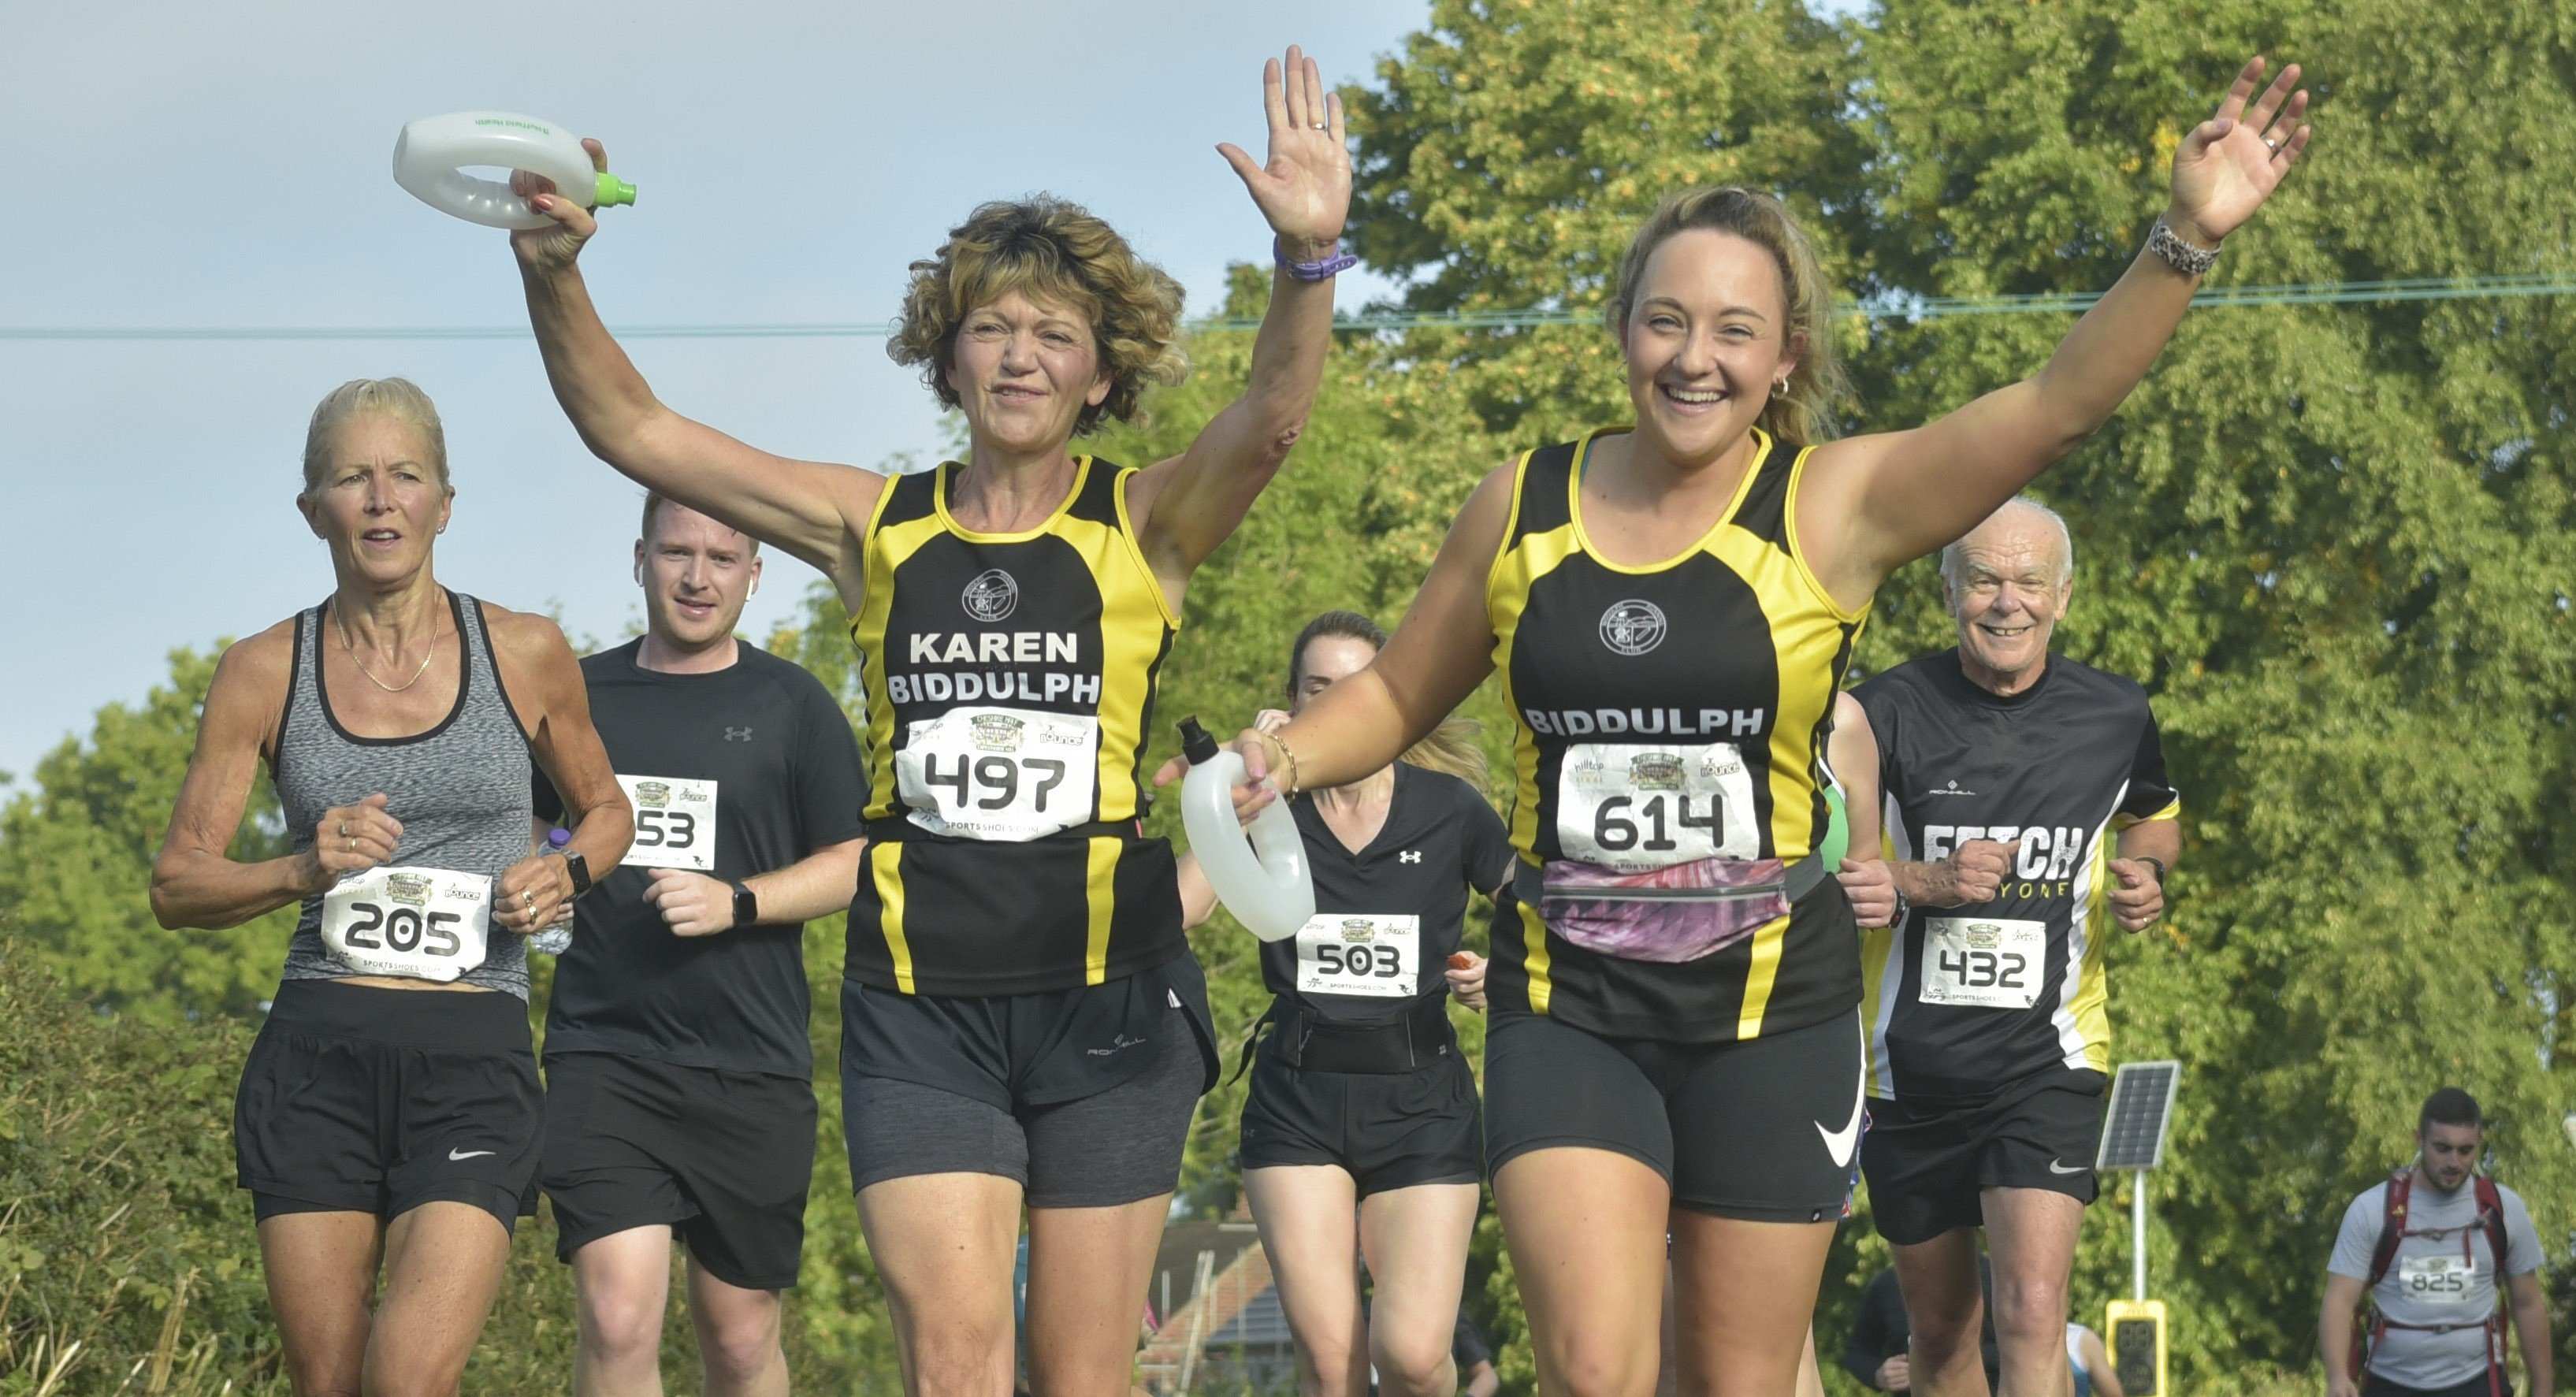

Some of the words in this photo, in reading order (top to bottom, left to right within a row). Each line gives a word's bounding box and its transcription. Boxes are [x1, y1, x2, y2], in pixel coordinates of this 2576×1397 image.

[909, 632, 1077, 663] KAREN
[887, 671, 1100, 704] BIDDULPH
[1525, 708, 1764, 737] BIDDULPH
[925, 752, 1066, 812] 497
[636, 810, 695, 849] 53
[1594, 793, 1724, 852] 614
[345, 902, 461, 957] 205
[1317, 945, 1400, 978] 503
[1939, 949, 2026, 988] 432
[2411, 1272, 2463, 1291] 825
